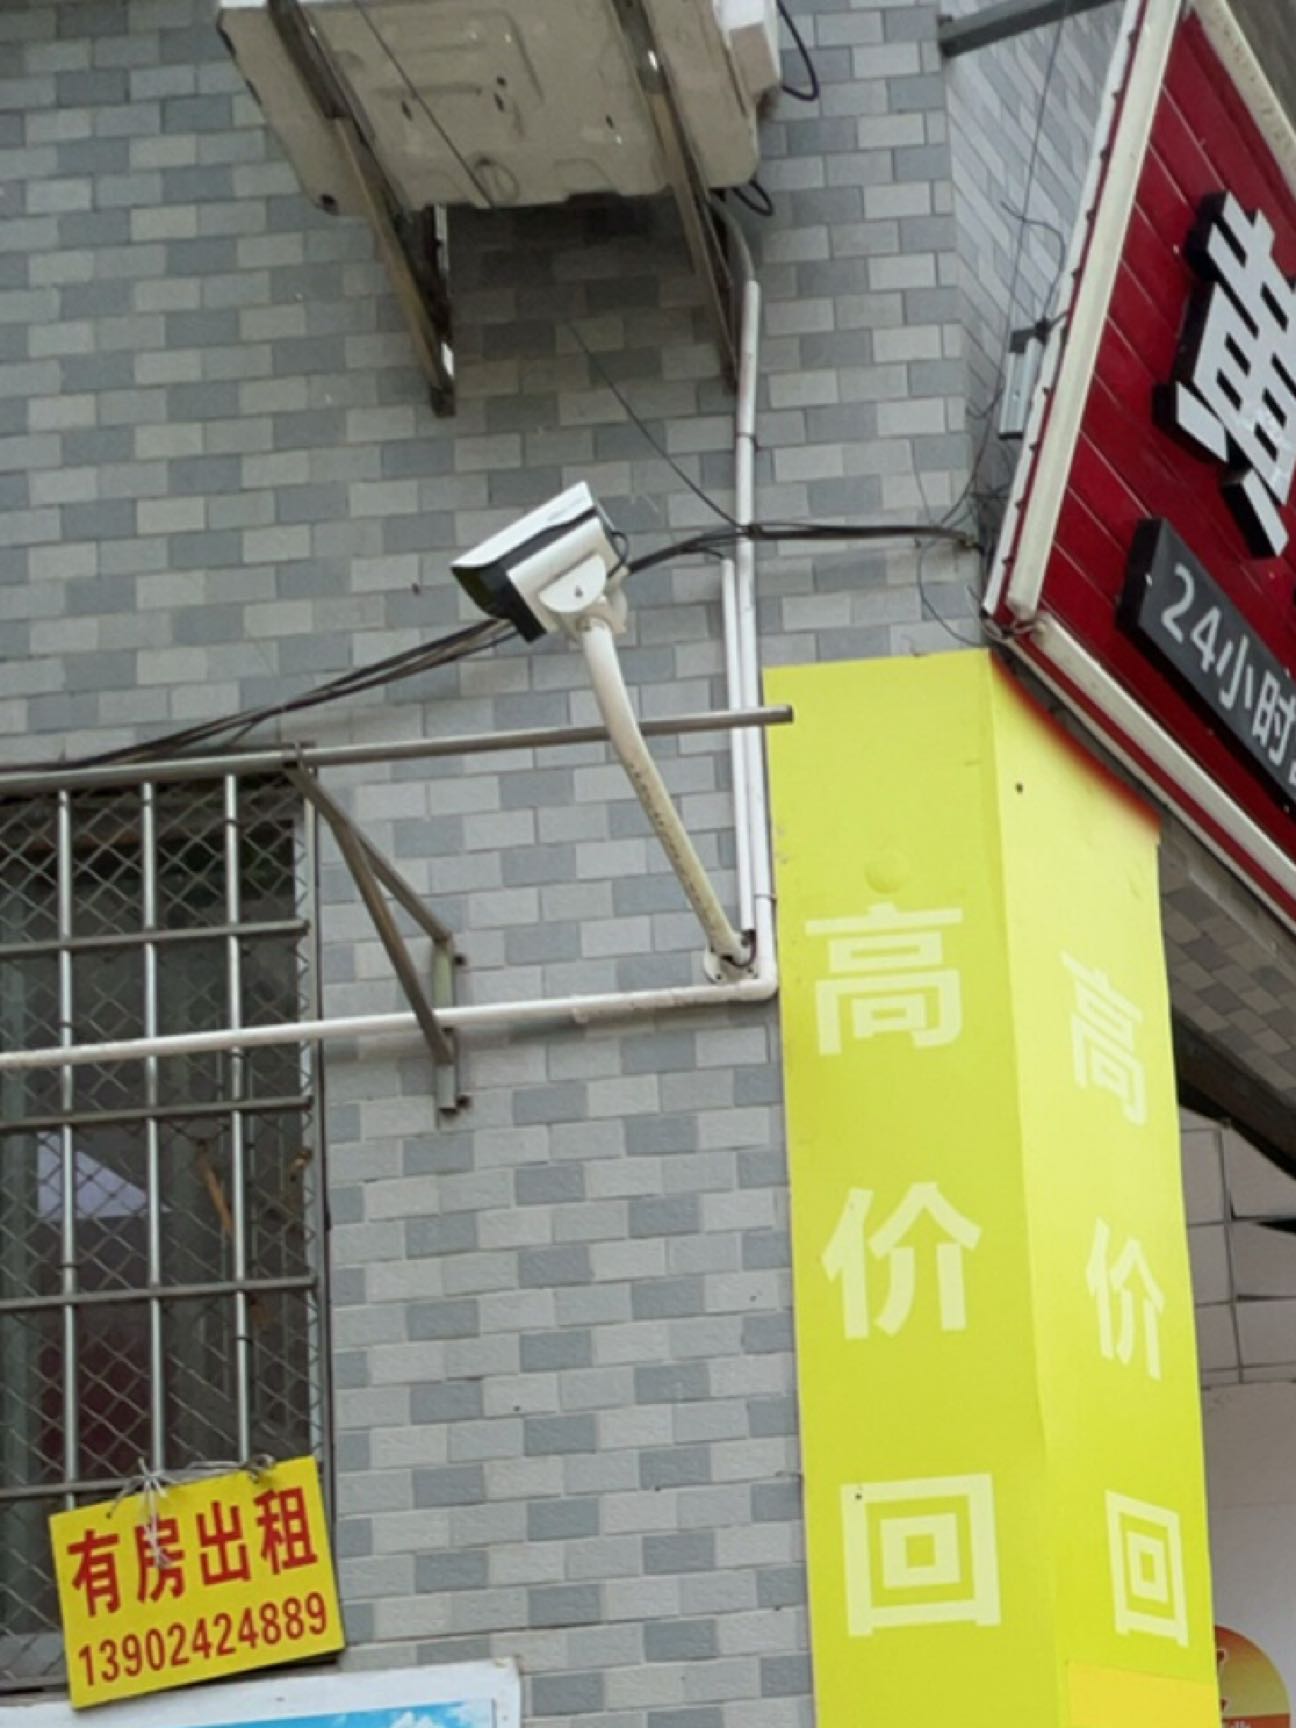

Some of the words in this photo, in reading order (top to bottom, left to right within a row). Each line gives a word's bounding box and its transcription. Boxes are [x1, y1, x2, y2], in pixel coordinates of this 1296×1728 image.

[67, 1485, 319, 1619] 有房出租
[78, 1590, 328, 1686] 13902424889
